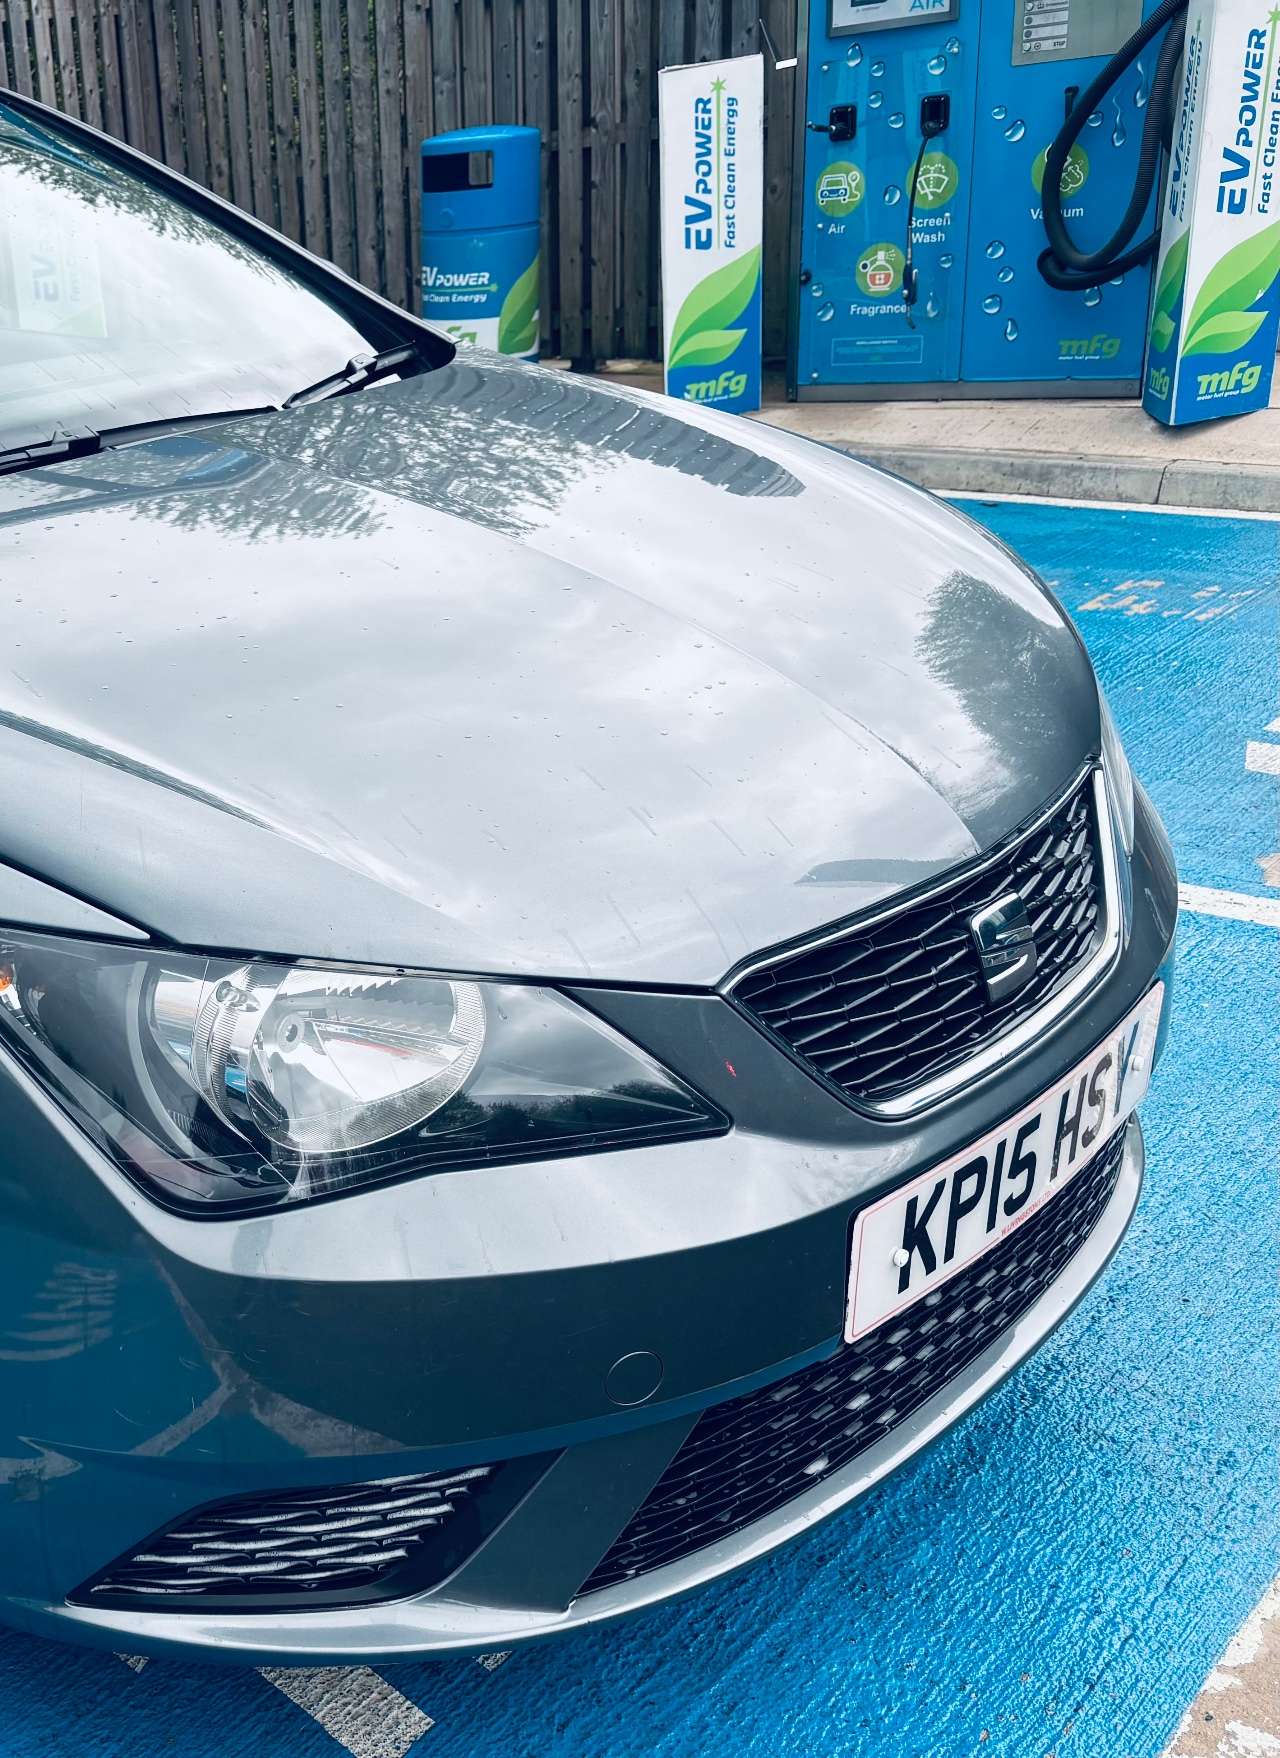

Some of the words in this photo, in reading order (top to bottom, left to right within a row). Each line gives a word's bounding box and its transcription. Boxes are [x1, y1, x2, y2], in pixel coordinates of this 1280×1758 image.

[724, 97, 738, 157] Energy
[1263, 109, 1280, 168] Clean
[724, 163, 736, 209] Clean
[1258, 172, 1273, 214] Fast
[911, 214, 951, 228] Screen
[1030, 207, 1084, 220] Vaum
[725, 215, 736, 248] Fast
[828, 223, 846, 235] Air
[912, 231, 945, 243] Wash
[451, 293, 487, 304] Energy
[850, 304, 907, 316] Fragrance
[1058, 334, 1120, 358] mfg
[685, 370, 748, 400] mfg
[1197, 361, 1262, 394] mfg
[897, 1113, 1041, 1294] KP15
[1049, 1021, 1140, 1182] HSY
